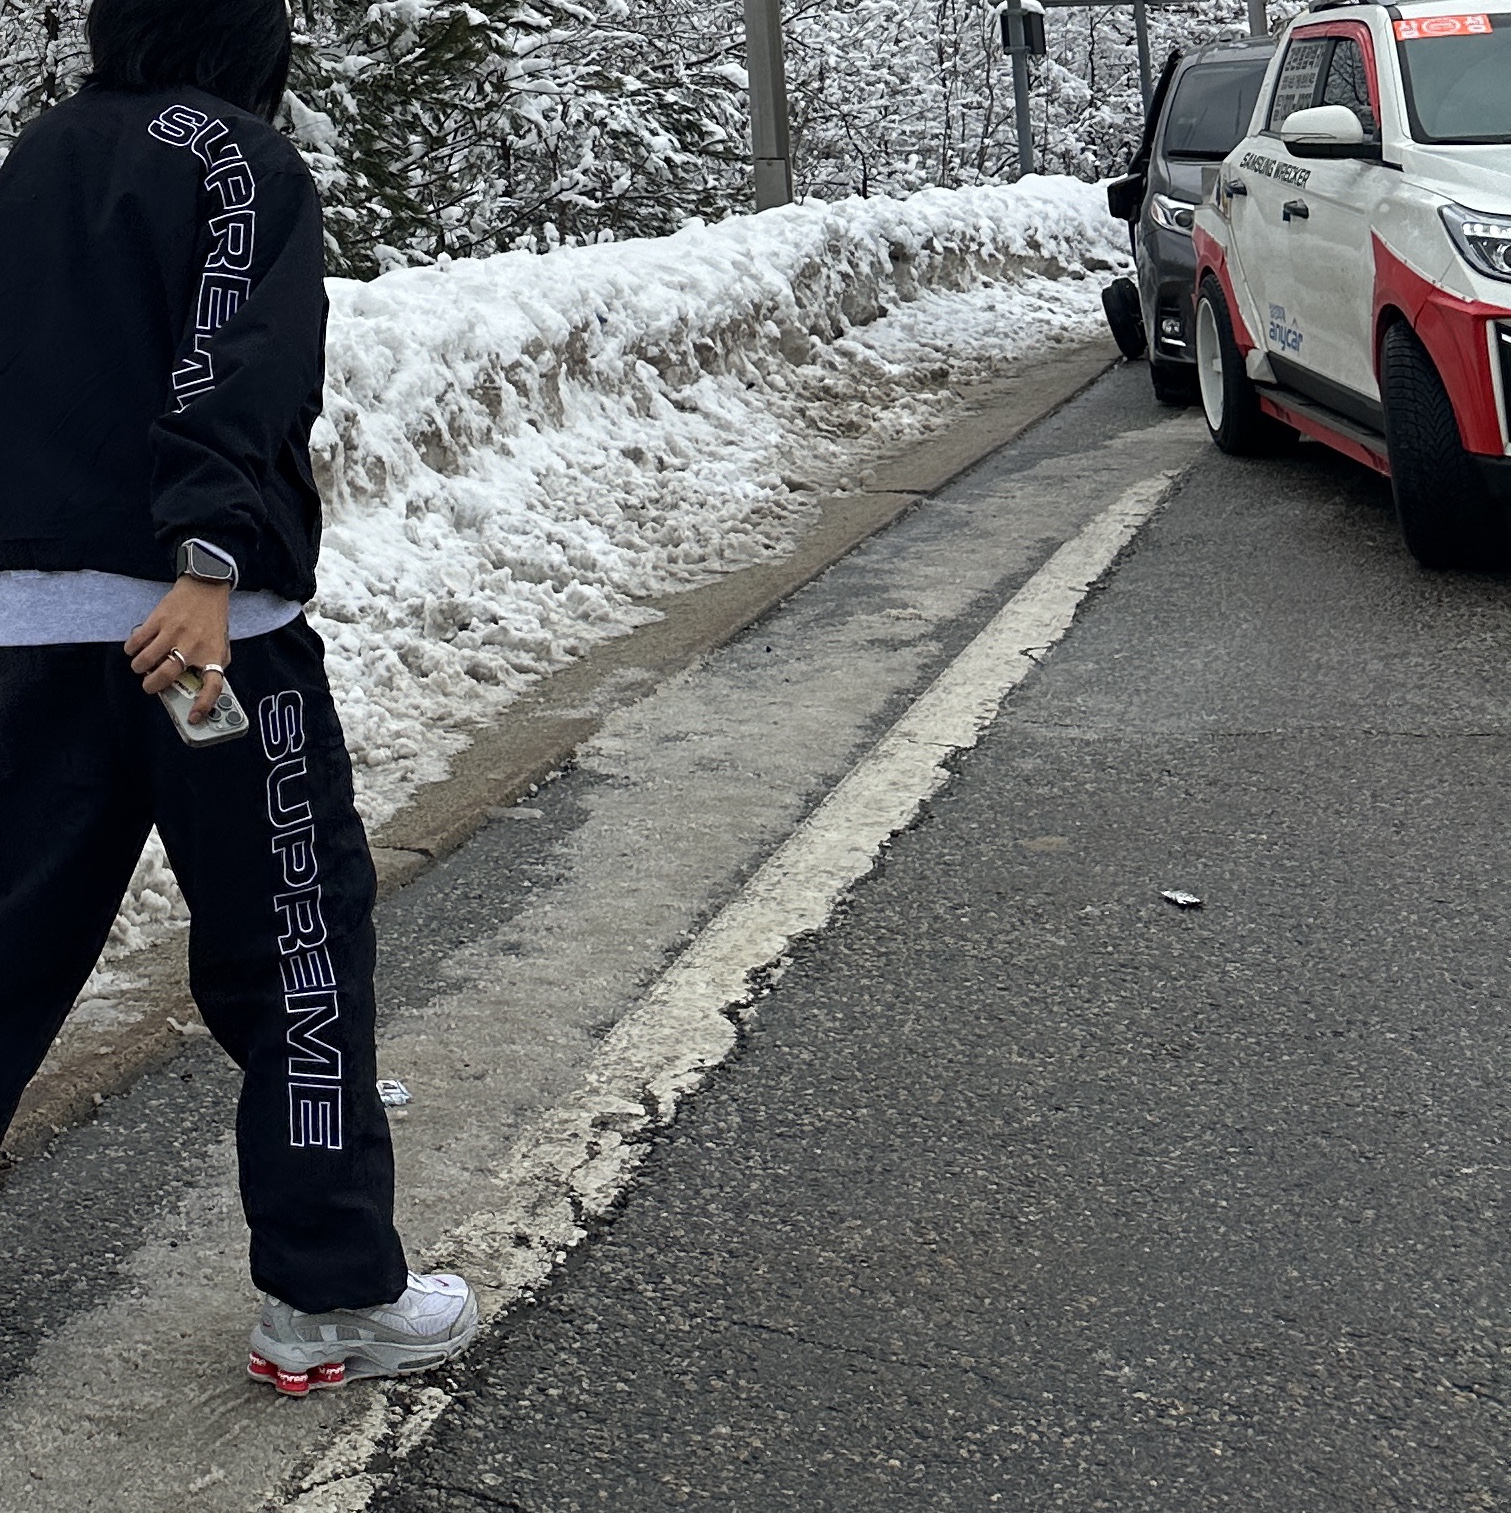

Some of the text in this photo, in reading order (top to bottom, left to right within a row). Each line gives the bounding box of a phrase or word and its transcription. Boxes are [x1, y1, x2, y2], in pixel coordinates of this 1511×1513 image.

[147, 104, 256, 414] SUPREM
[1269, 321, 1304, 351] anycar
[258, 689, 344, 1151] SUPREME
